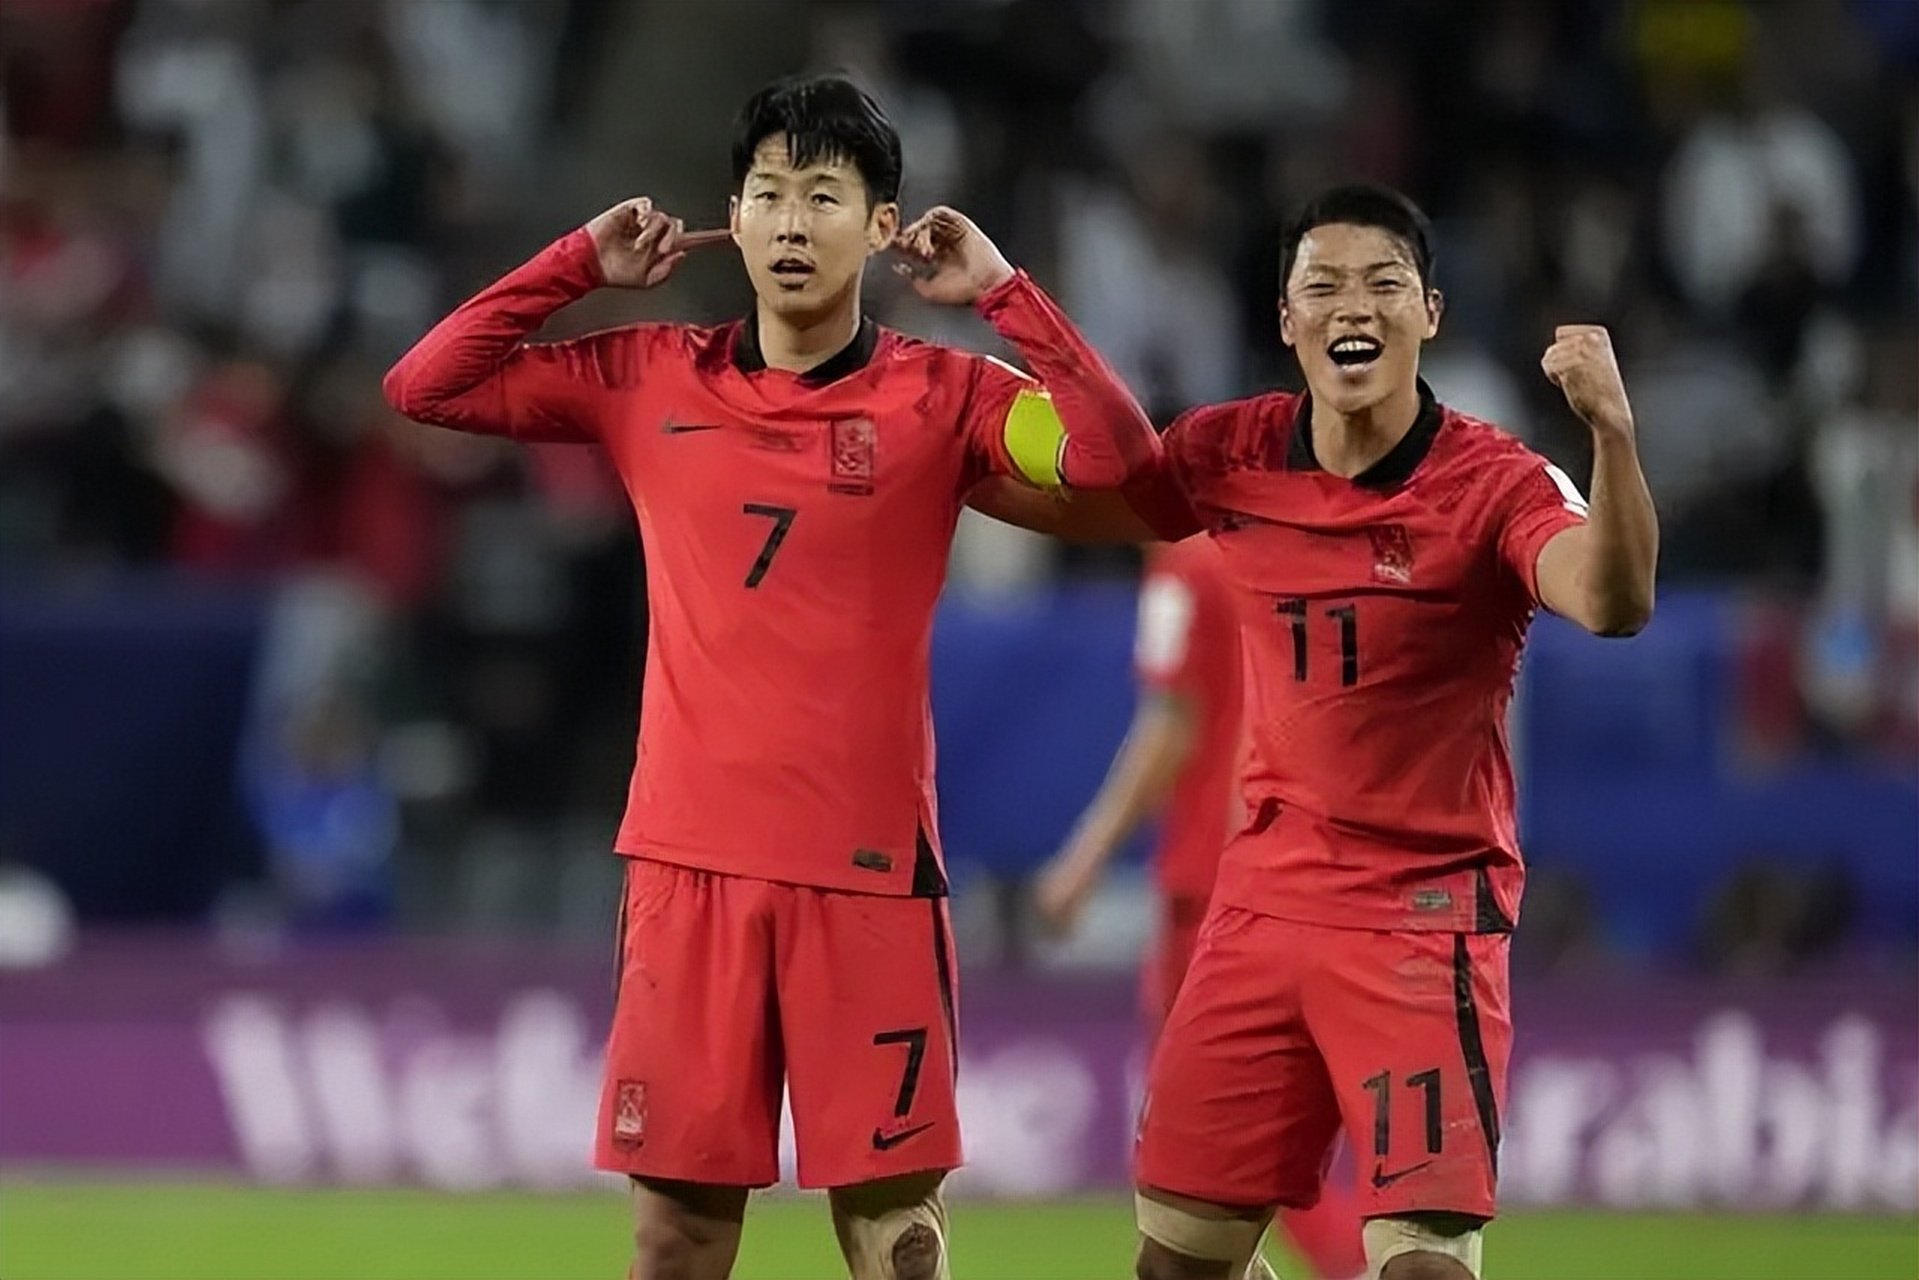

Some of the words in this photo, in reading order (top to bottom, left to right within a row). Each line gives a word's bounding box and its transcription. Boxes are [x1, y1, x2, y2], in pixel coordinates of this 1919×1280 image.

[743, 503, 797, 588] 7
[1276, 598, 1357, 687] 11
[873, 1026, 928, 1118] 7
[1362, 1068, 1442, 1154] 11
